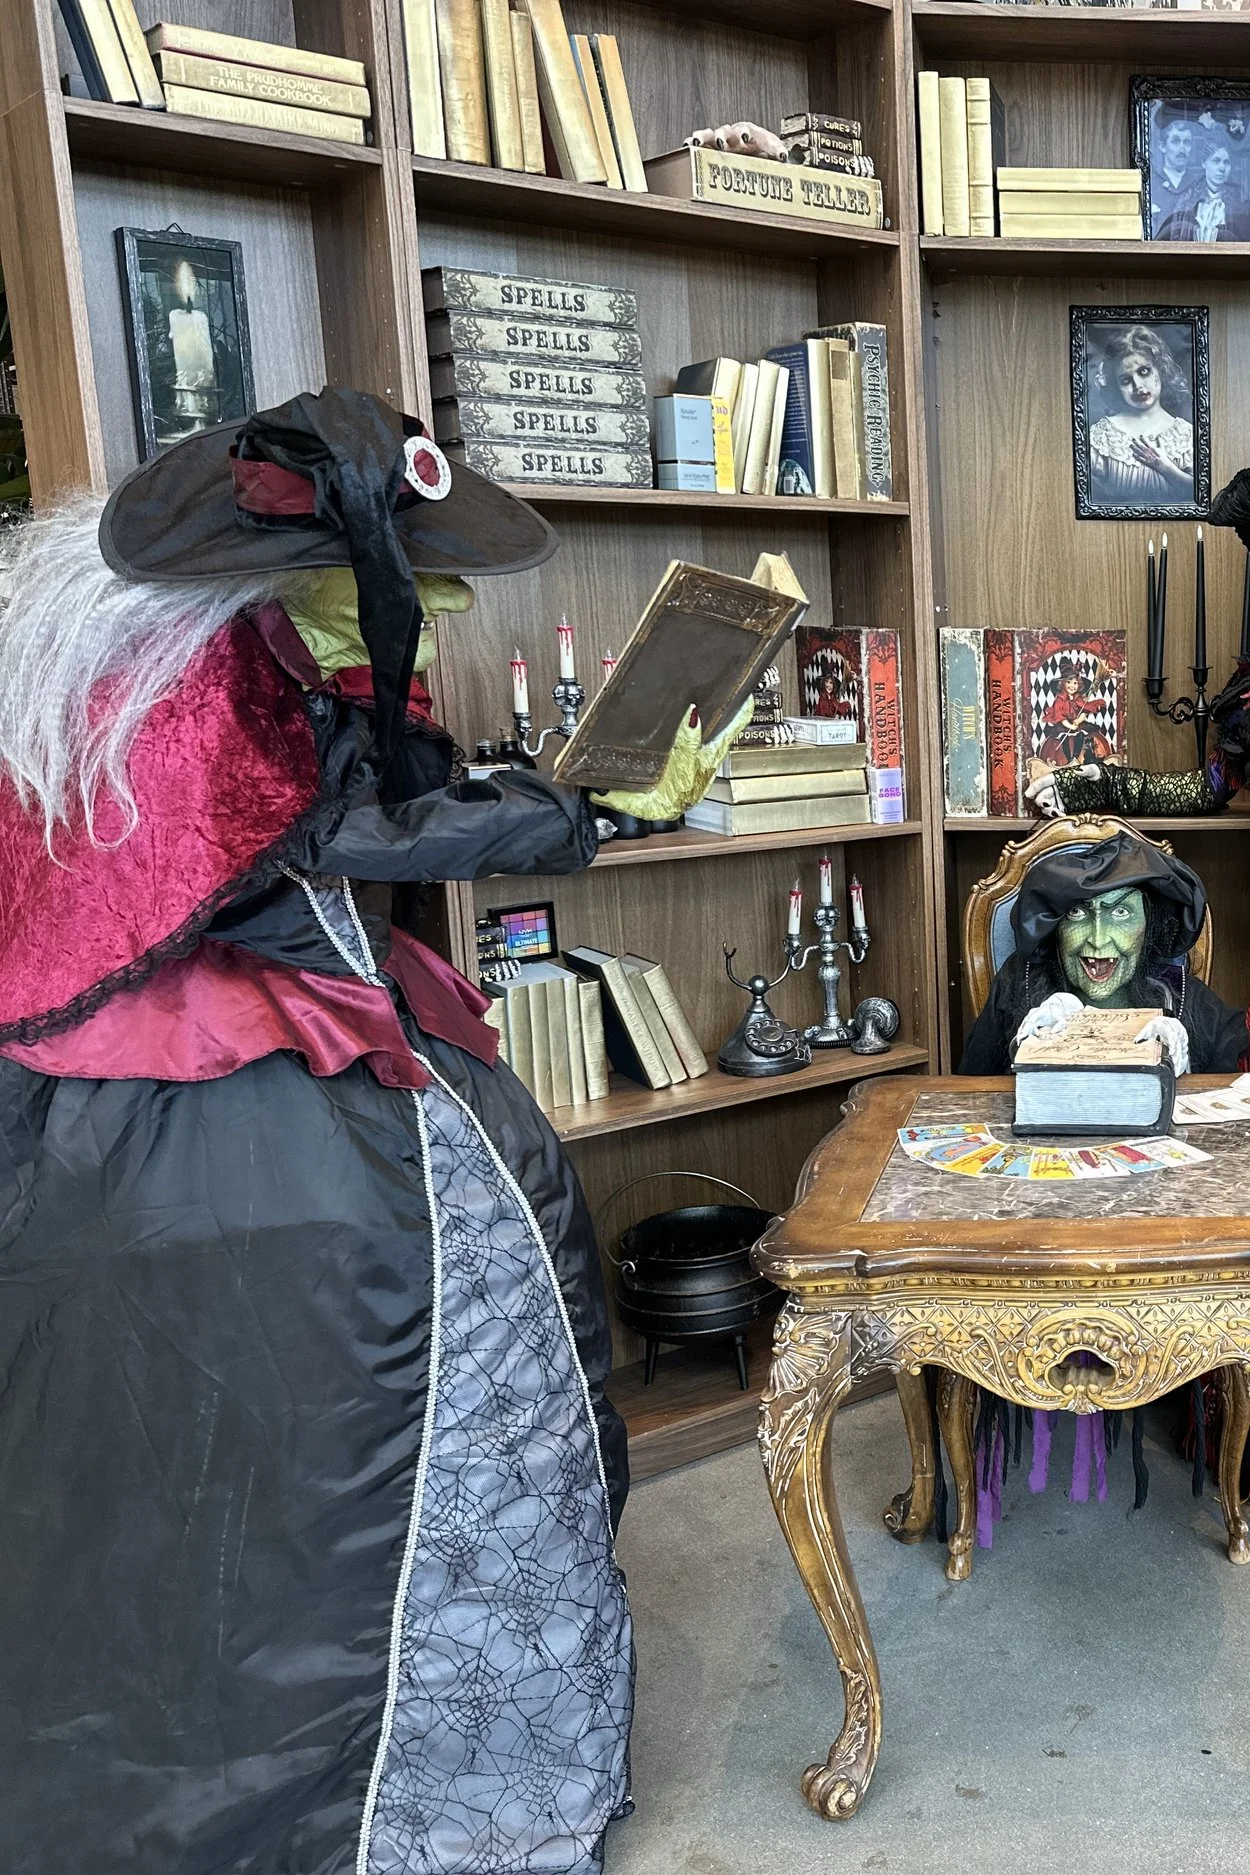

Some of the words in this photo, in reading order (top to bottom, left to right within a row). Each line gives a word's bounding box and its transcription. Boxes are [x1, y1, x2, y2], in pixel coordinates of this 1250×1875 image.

[209, 76, 255, 96] FAMILY
[258, 84, 332, 107] COOKBOOK
[216, 65, 243, 80] THE
[247, 71, 323, 94] PRUDHOMME
[824, 121, 850, 133] CURES
[820, 138, 853, 151] POTIONS
[818, 153, 855, 168] POISONS
[708, 163, 793, 202] FORTUNE
[800, 179, 871, 216] TELLER
[500, 285, 587, 313] SPELLS
[506, 327, 591, 353] SPELLS
[508, 370, 593, 396] SPELLS
[863, 342, 881, 409] PSYCHIC
[513, 411, 598, 434] SPELLS
[867, 415, 885, 485] READING
[521, 453, 605, 475] SPELLS
[755, 698, 771, 707] RES
[753, 714, 775, 722] TIONS
[874, 681, 889, 767] HANDBOO
[992, 679, 1003, 769] HANDBOOK
[740, 730, 775, 739] POISONS
[828, 732, 847, 740] TAROT
[514, 938, 538, 947] ULTIMATE
[641, 1040, 660, 1073] WIDOW
